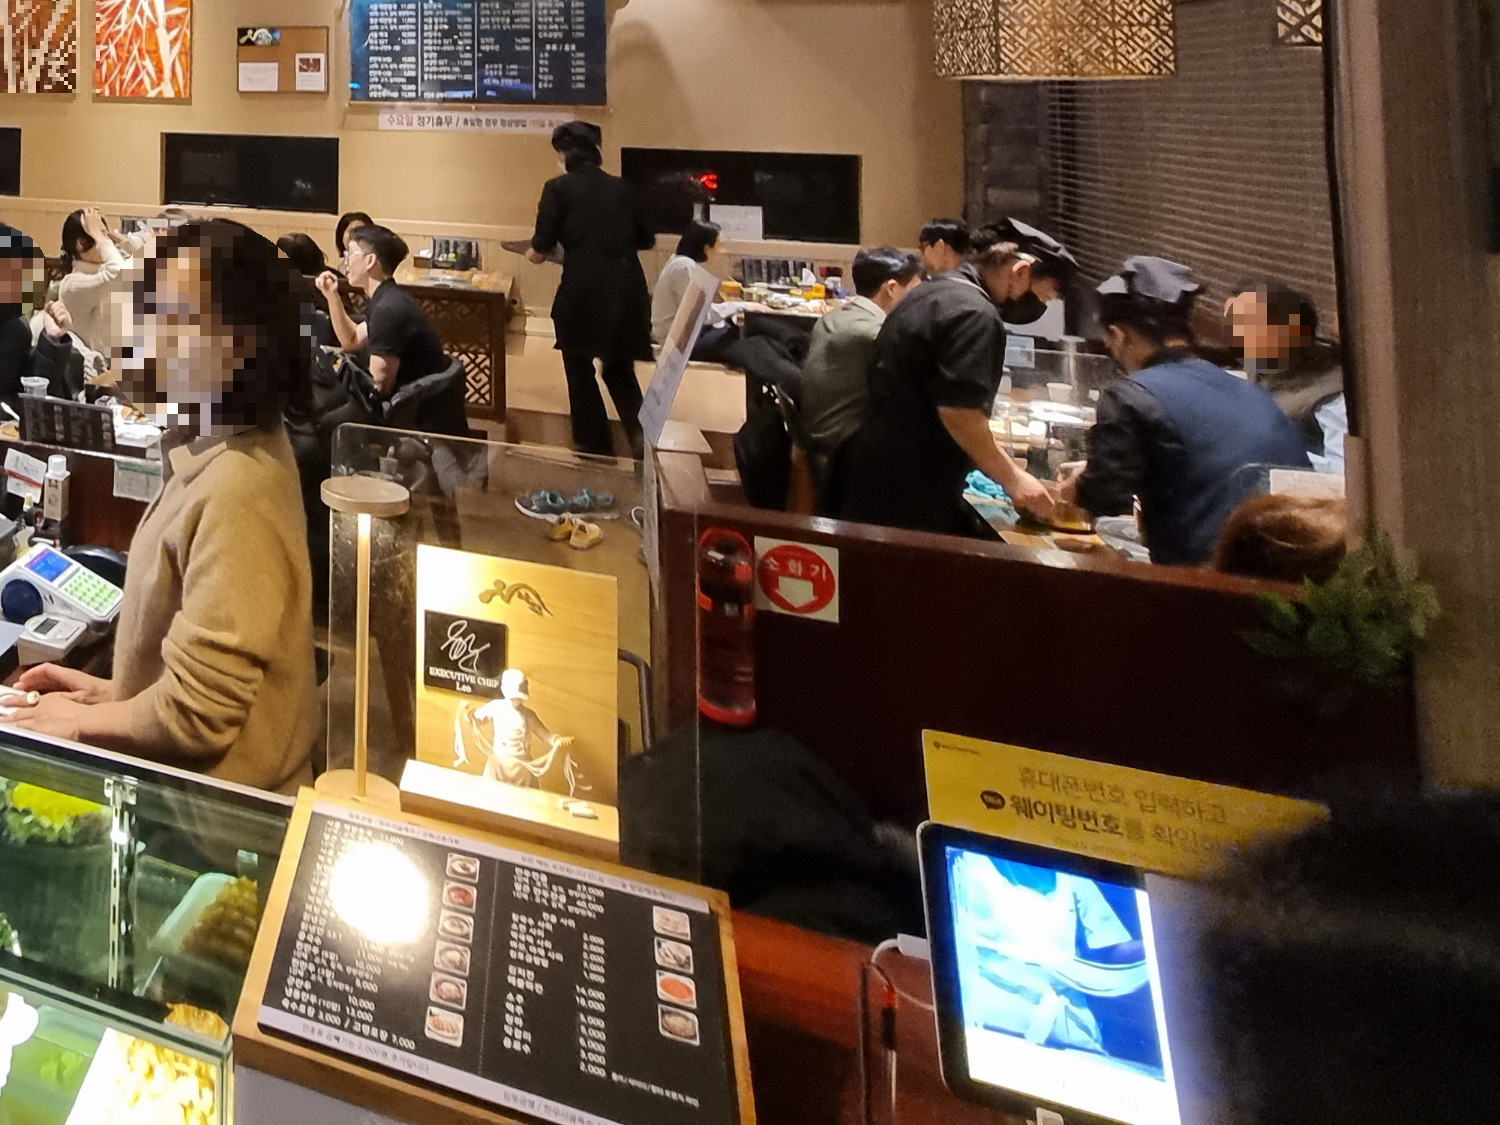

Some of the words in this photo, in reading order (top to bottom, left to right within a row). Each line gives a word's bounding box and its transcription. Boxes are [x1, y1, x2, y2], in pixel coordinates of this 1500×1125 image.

[764, 557, 827, 581] 소화기
[429, 666, 476, 685] EXECUTIVE
[477, 676, 500, 689] CHEF
